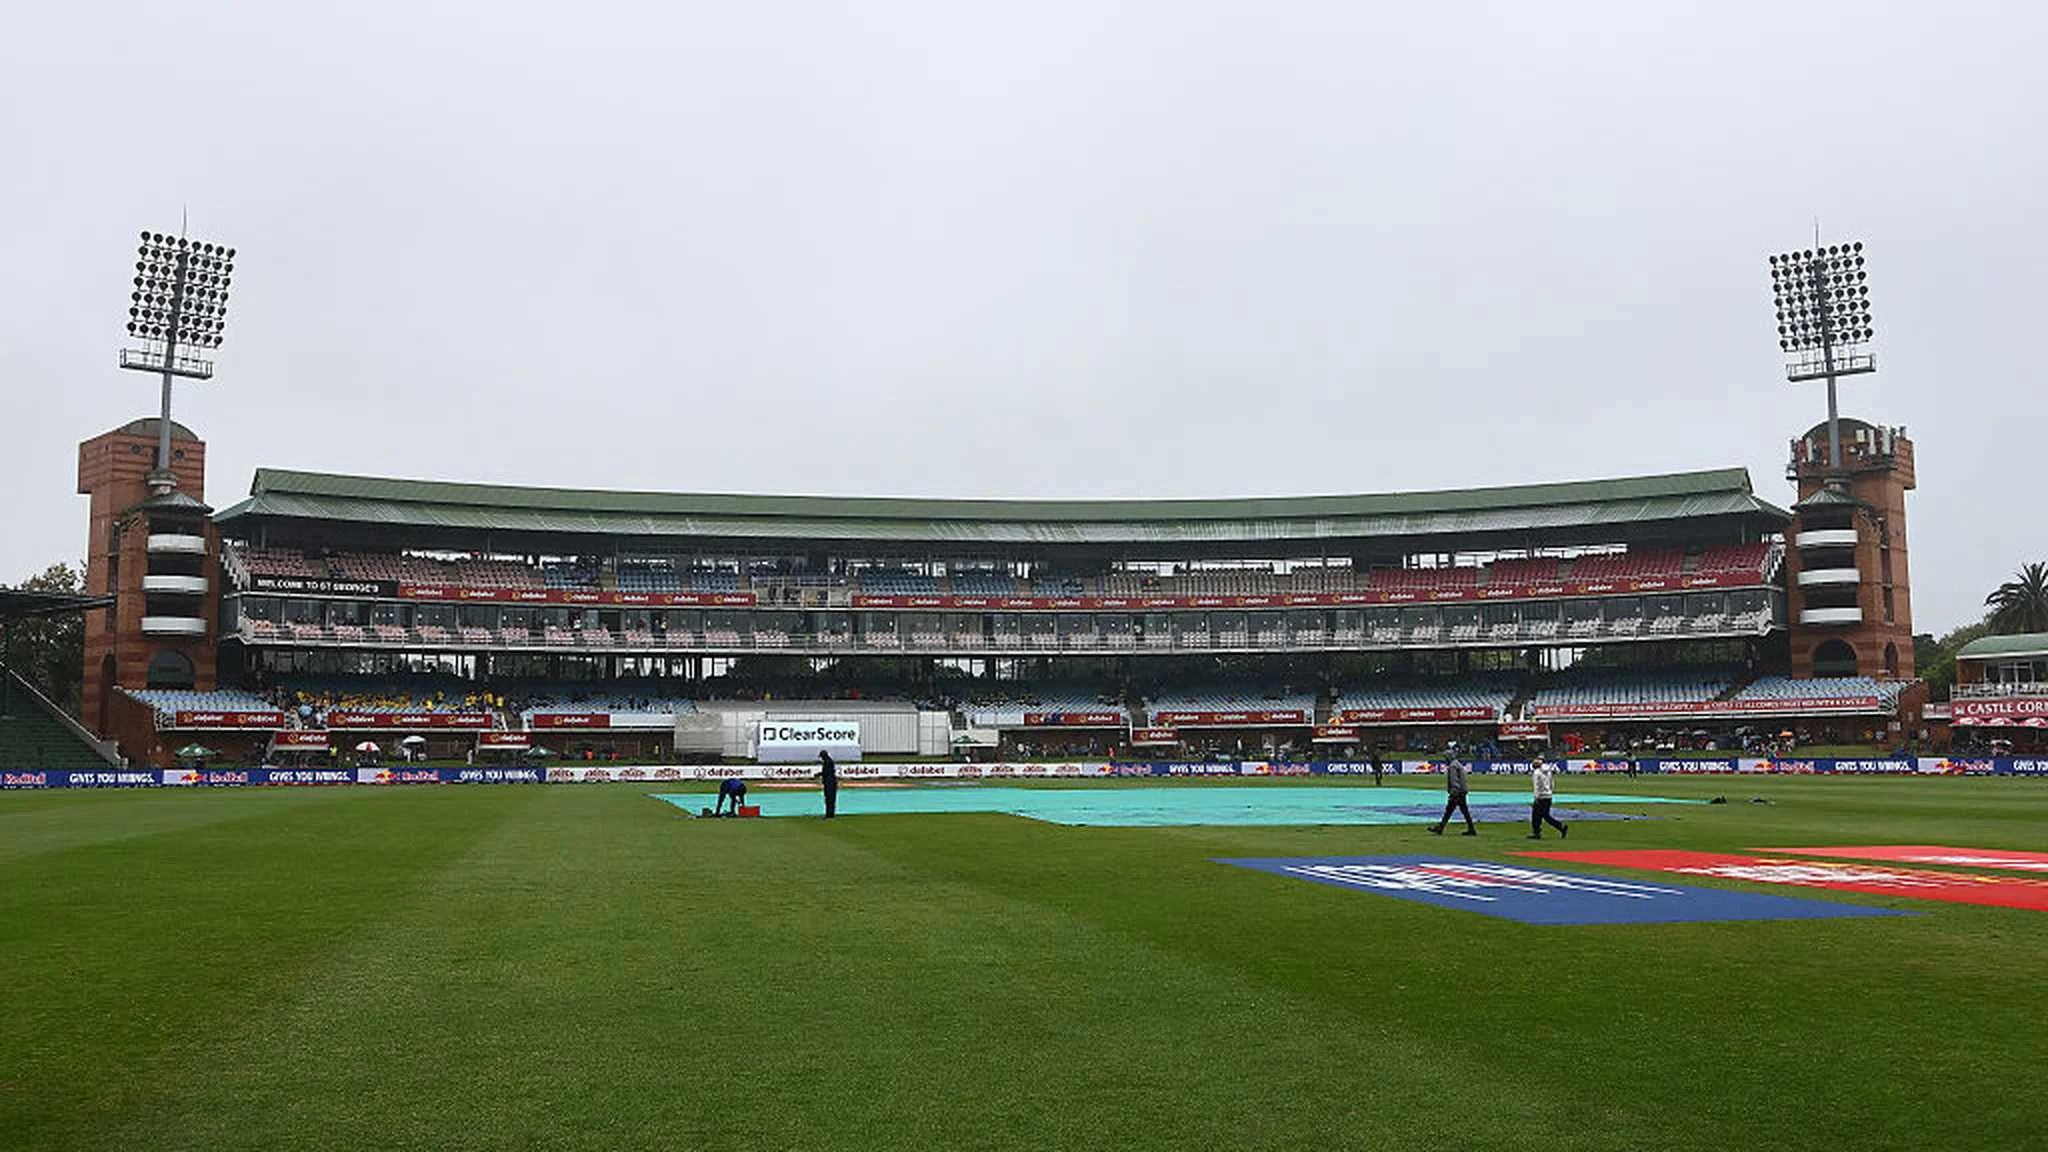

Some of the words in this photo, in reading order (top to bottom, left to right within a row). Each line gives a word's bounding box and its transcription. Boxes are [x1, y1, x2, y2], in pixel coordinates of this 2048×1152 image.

[307, 581, 318, 590] TO
[1967, 702, 2013, 715] CASTLE
[779, 727, 855, 740] ClearScore
